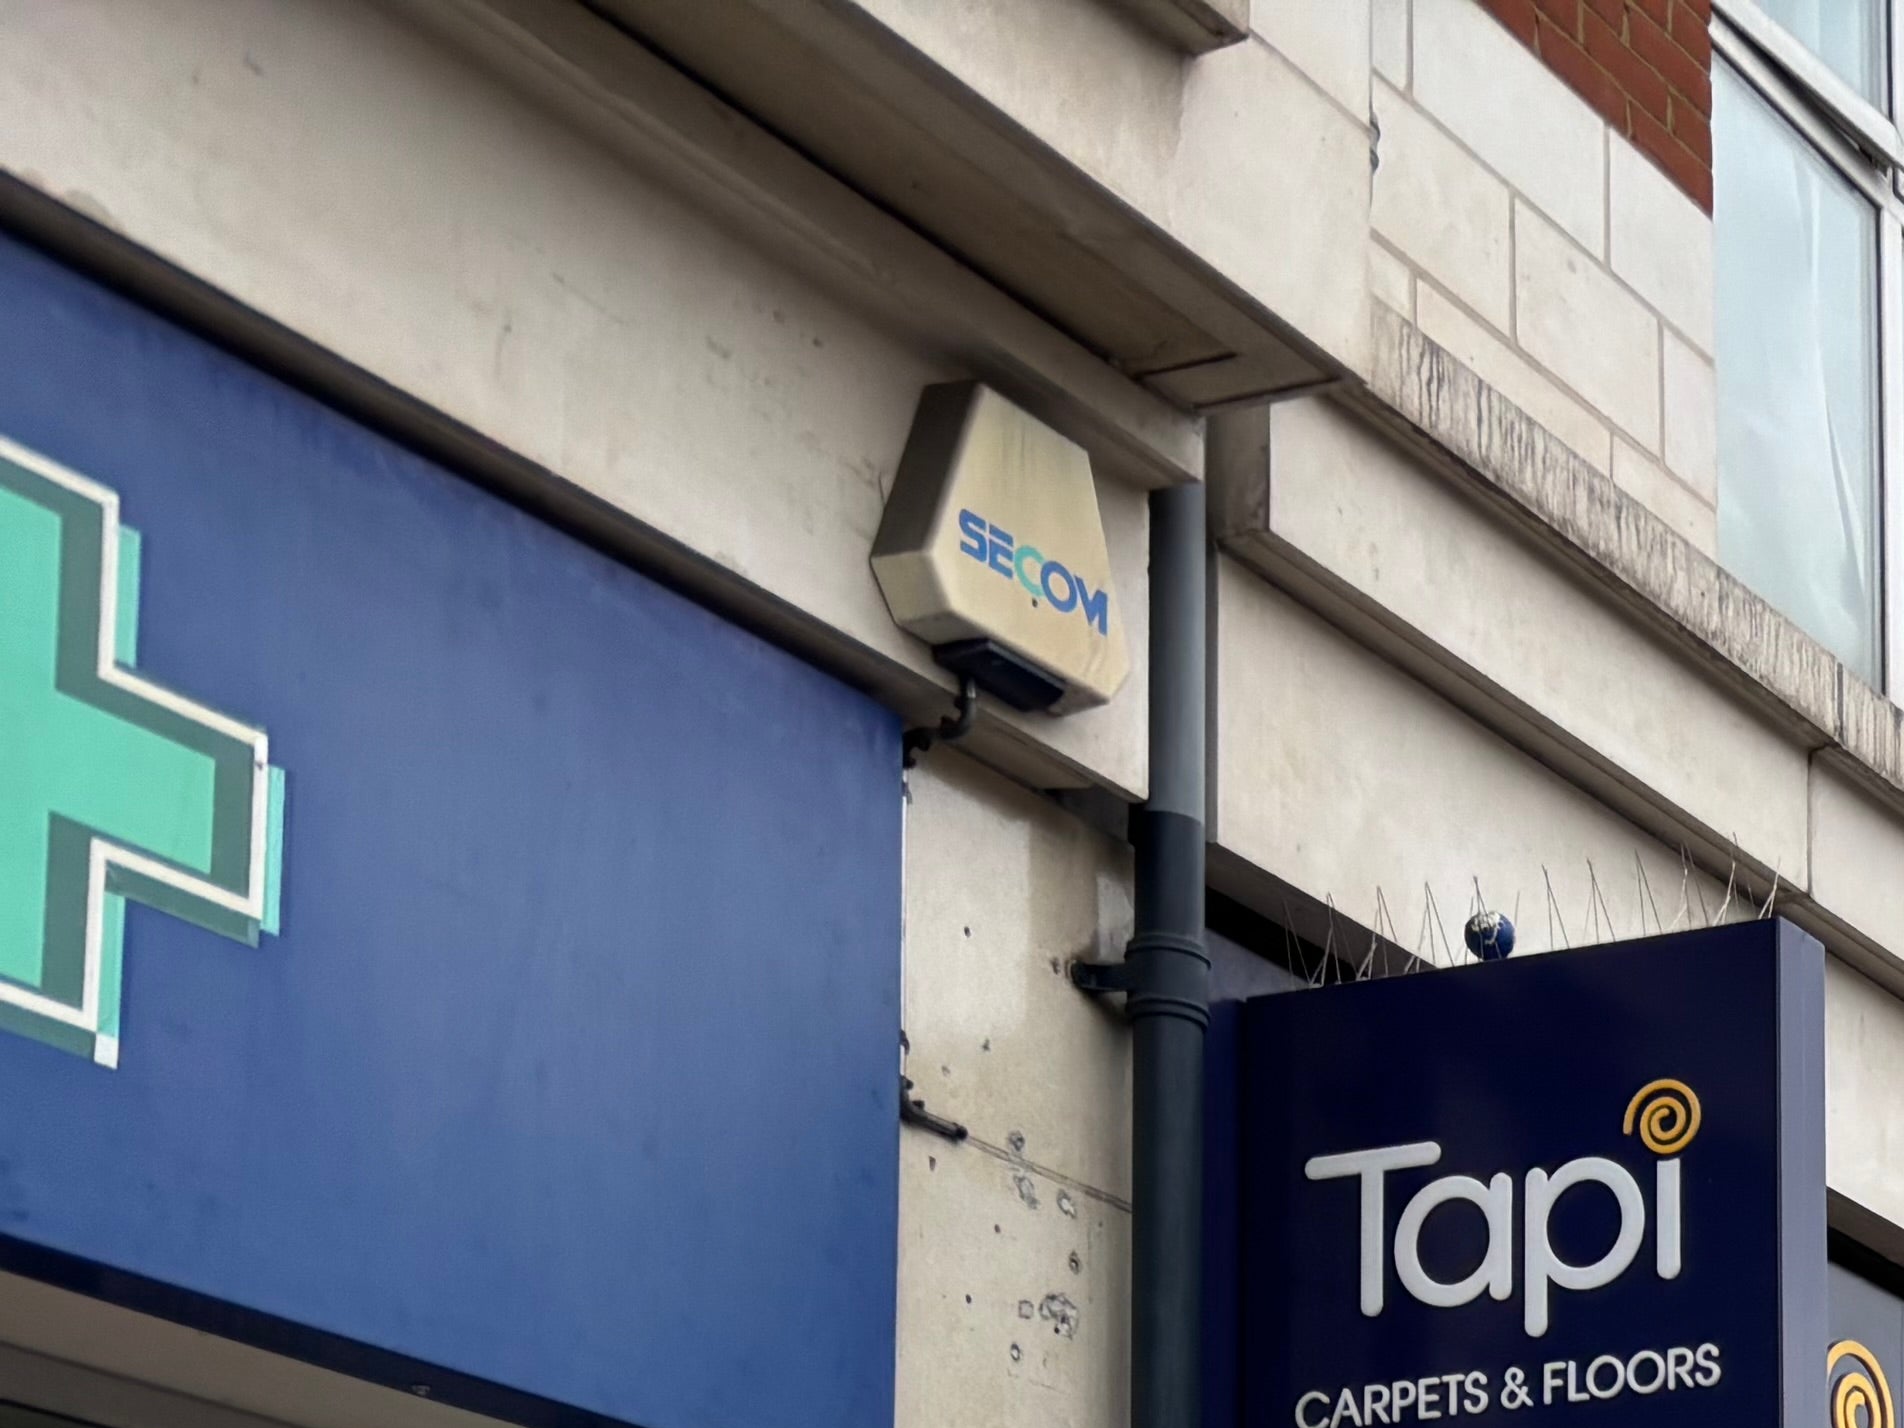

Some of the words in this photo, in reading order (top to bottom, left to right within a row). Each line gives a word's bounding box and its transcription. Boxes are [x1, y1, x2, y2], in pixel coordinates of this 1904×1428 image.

[959, 508, 1108, 637] SECOM
[1305, 1078, 1700, 1337] Tapi
[1501, 1367, 1533, 1410] &
[1543, 1342, 1721, 1406] FLOORS
